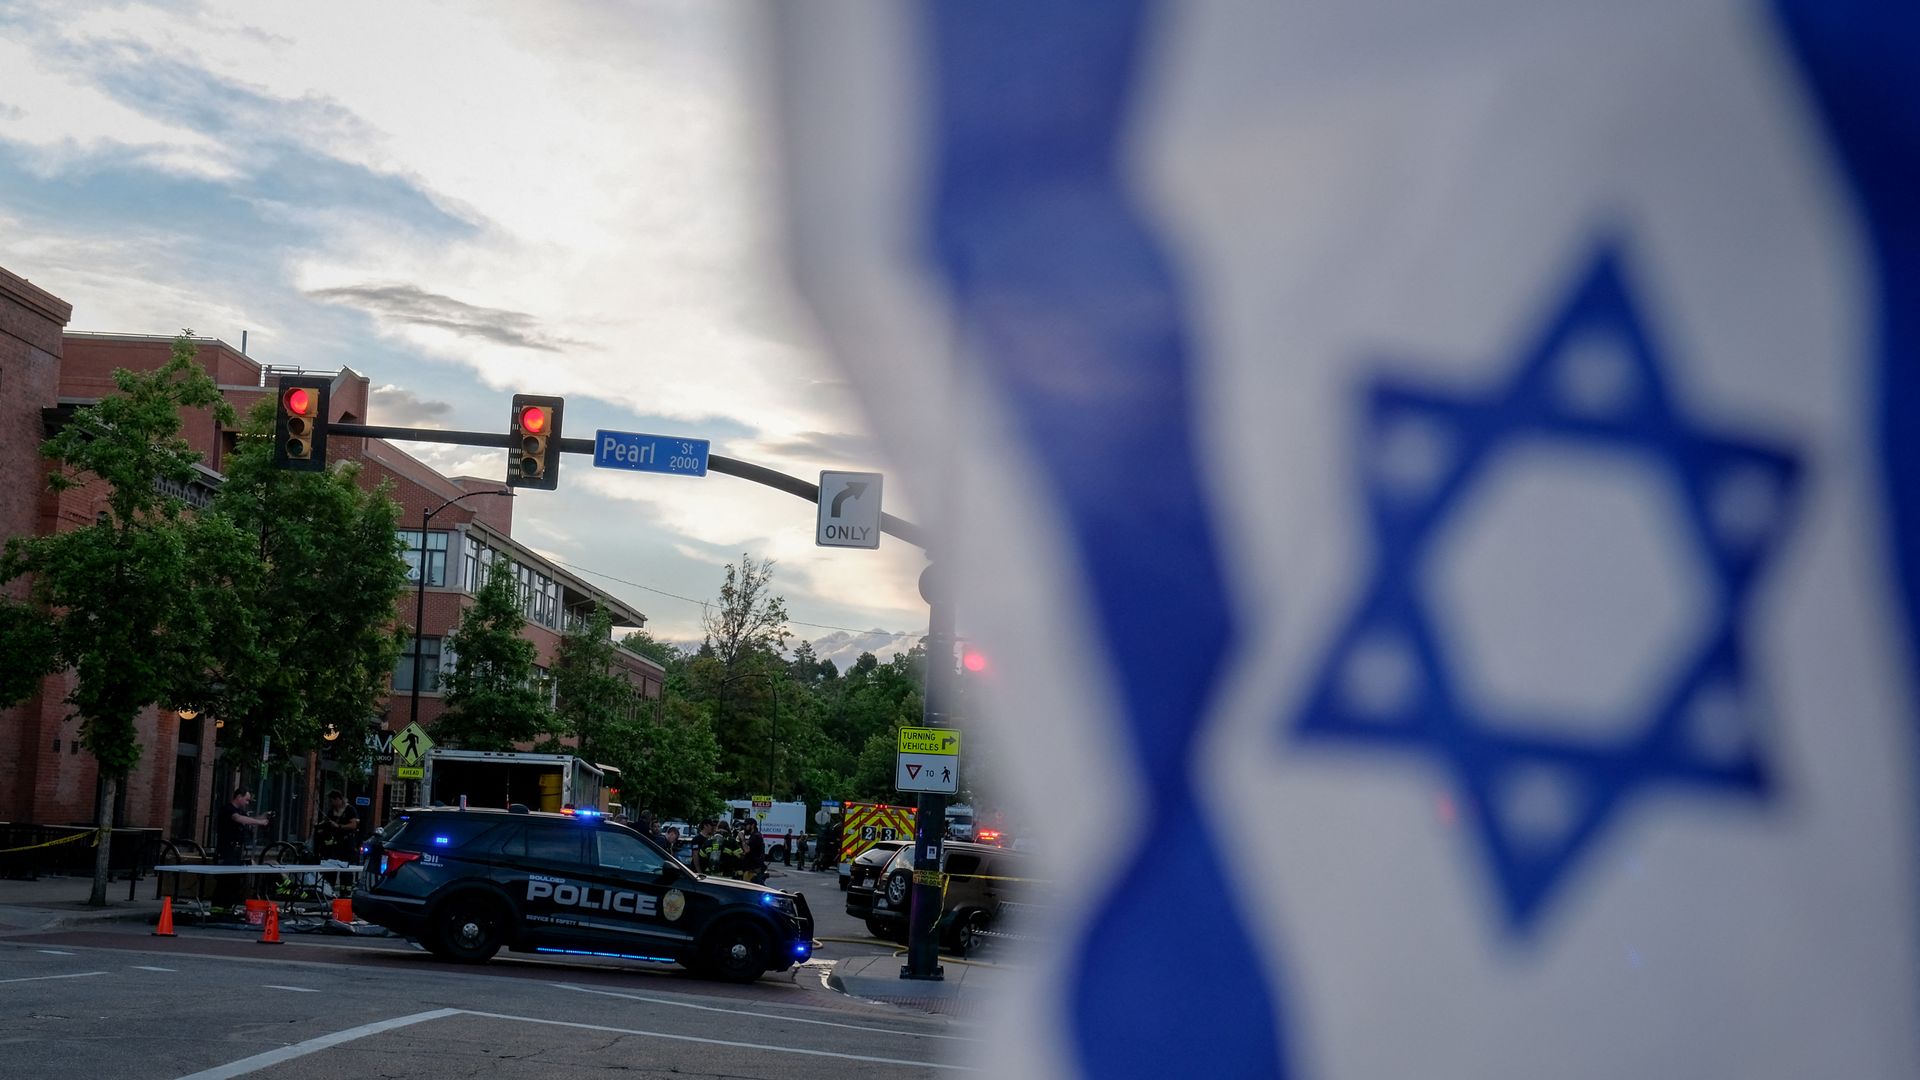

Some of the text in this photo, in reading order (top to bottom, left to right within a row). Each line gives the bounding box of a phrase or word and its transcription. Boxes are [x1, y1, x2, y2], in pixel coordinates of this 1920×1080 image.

[602, 437, 694, 464] Pearl St
[670, 456, 699, 470] 2000
[825, 524, 871, 541] ONLY
[903, 731, 936, 741] TURNING
[902, 742, 939, 751] VEHICLES
[402, 768, 420, 776] AHEAD
[925, 769, 935, 778] TO
[865, 827, 892, 841] 2 3
[424, 854, 439, 863] 911
[529, 874, 566, 884] BOULDER
[526, 880, 658, 917] POLICE
[526, 914, 549, 922] SERVICE
